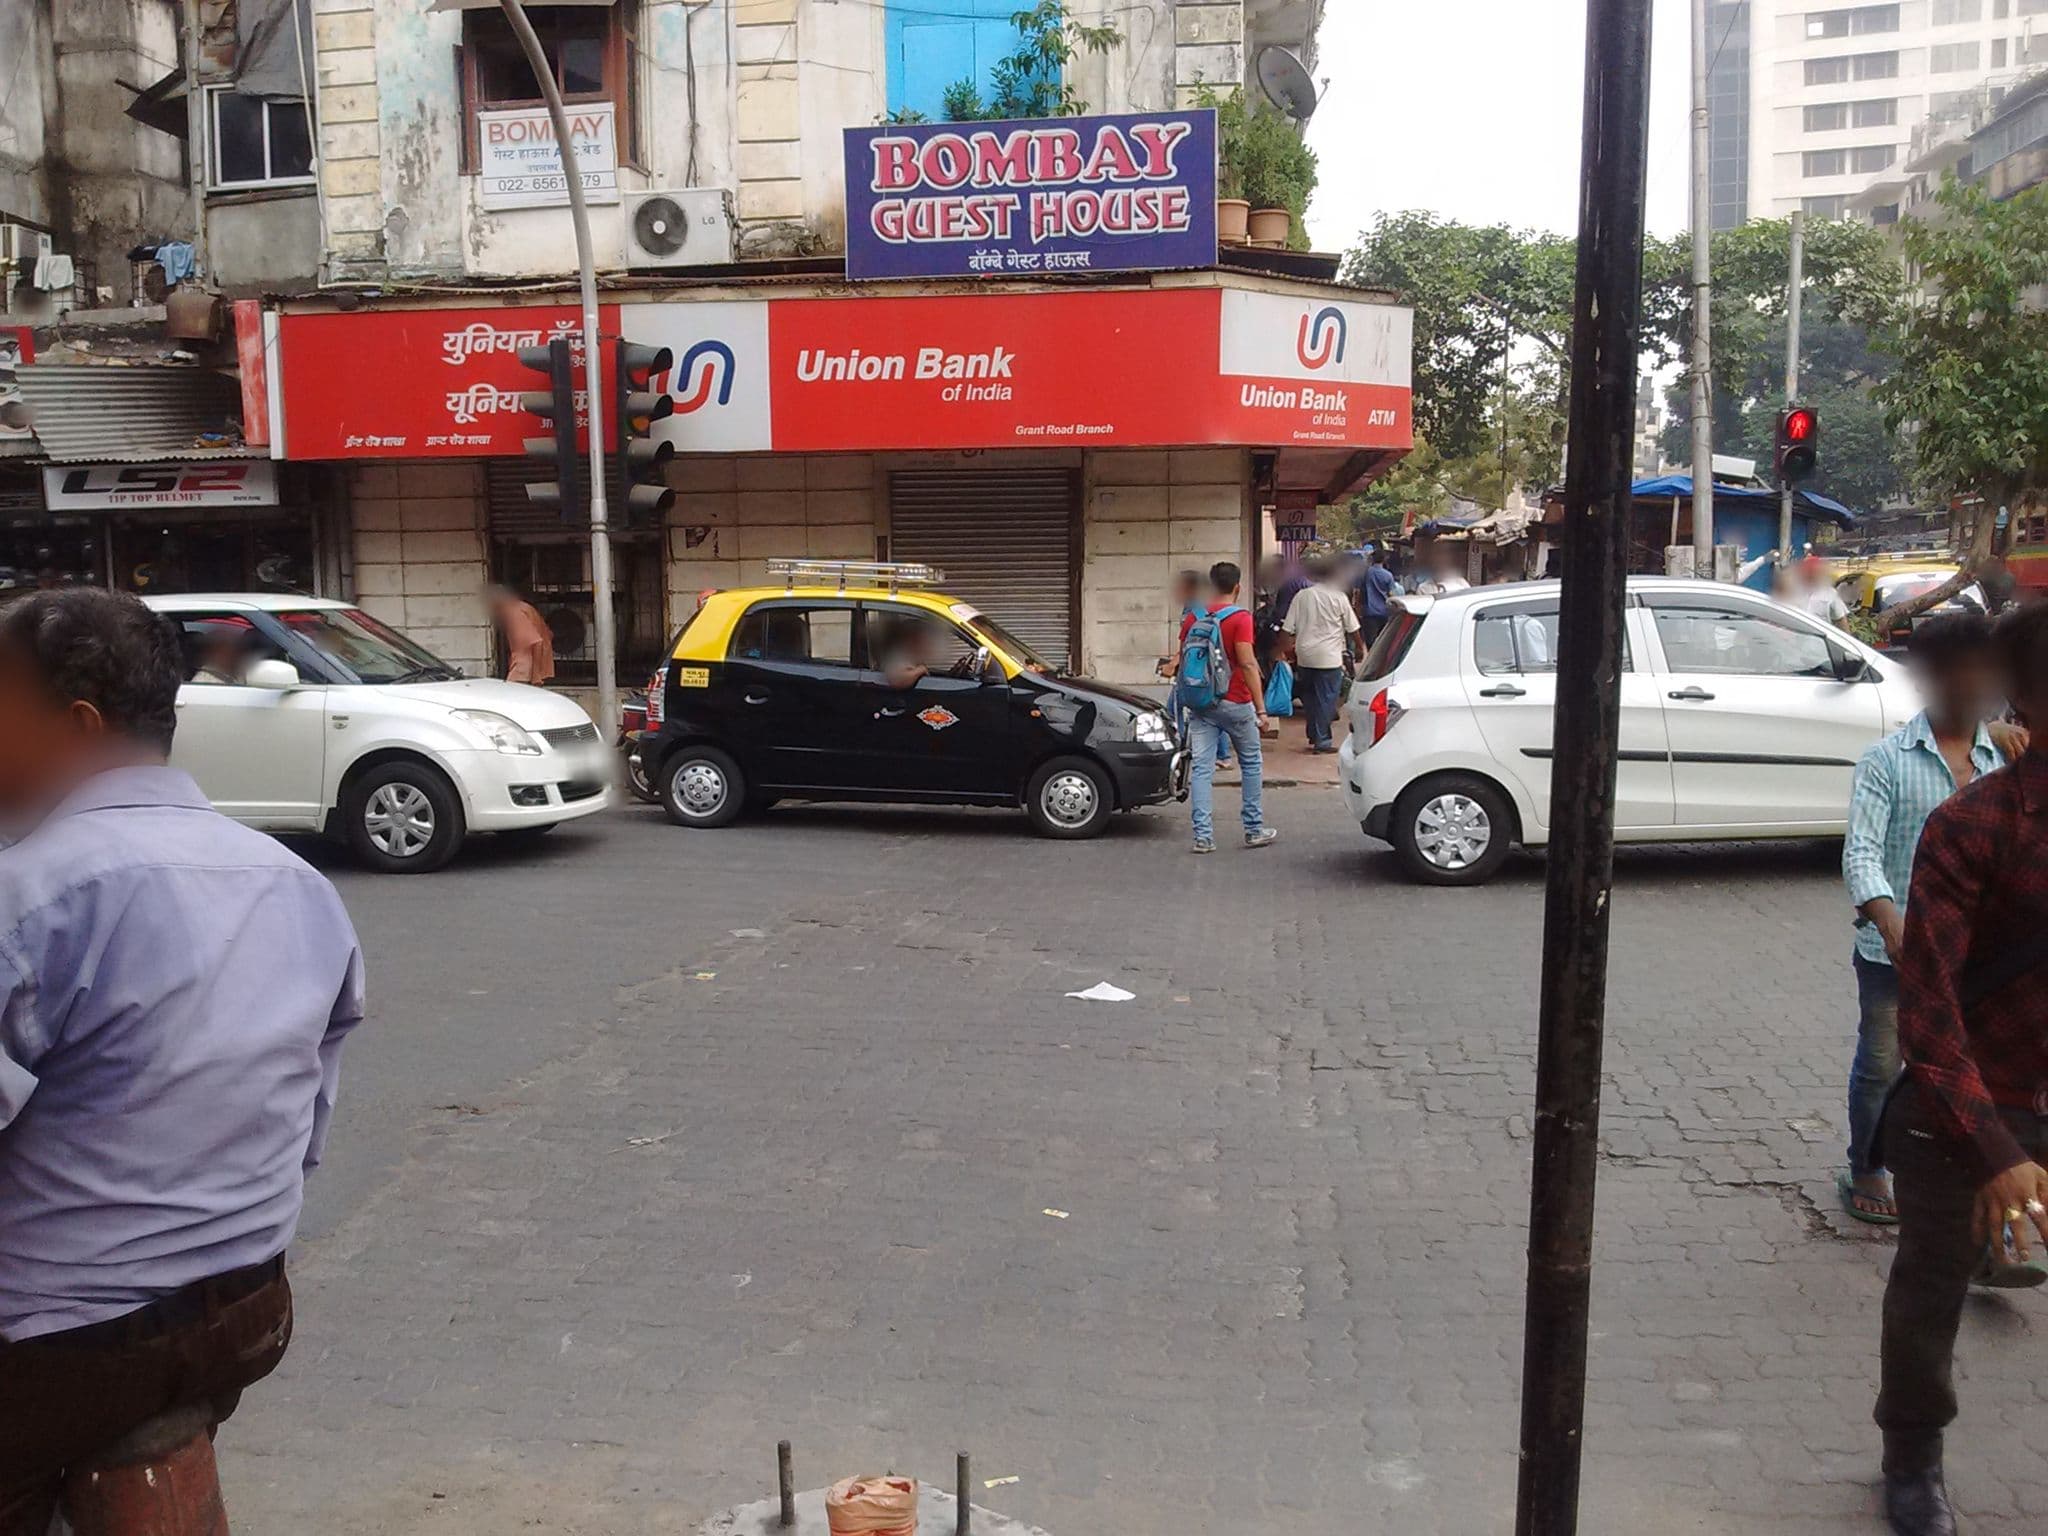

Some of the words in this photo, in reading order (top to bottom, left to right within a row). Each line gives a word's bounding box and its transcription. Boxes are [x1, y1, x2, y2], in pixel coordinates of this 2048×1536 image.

[487, 115, 605, 144] BOMAY
[870, 122, 1192, 193] BOMBAY
[533, 174, 602, 190] 656179
[871, 194, 1021, 245] GUEST
[1030, 185, 1192, 245] HOUSE
[968, 249, 1004, 270] बॉम्बे
[1007, 249, 1042, 269] गेस्ट
[1044, 250, 1092, 270] हाऊस
[797, 349, 904, 382] Union
[914, 346, 1016, 379] Bank
[941, 383, 961, 402] of
[966, 382, 1013, 402] India
[1240, 384, 1297, 409] Union
[1300, 388, 1349, 411] Bank
[446, 383, 528, 425] यूनिय
[1312, 413, 1323, 425] of
[1324, 414, 1347, 426] India
[1368, 409, 1397, 426] ATM
[1015, 425, 1043, 436] Grant
[1046, 425, 1073, 436] Road
[1075, 424, 1114, 434] Branch
[61, 466, 248, 494] LS2
[109, 494, 127, 503] TIP
[131, 494, 153, 503] TOP
[157, 493, 205, 502] HELMET
[1280, 528, 1312, 541] ATM
